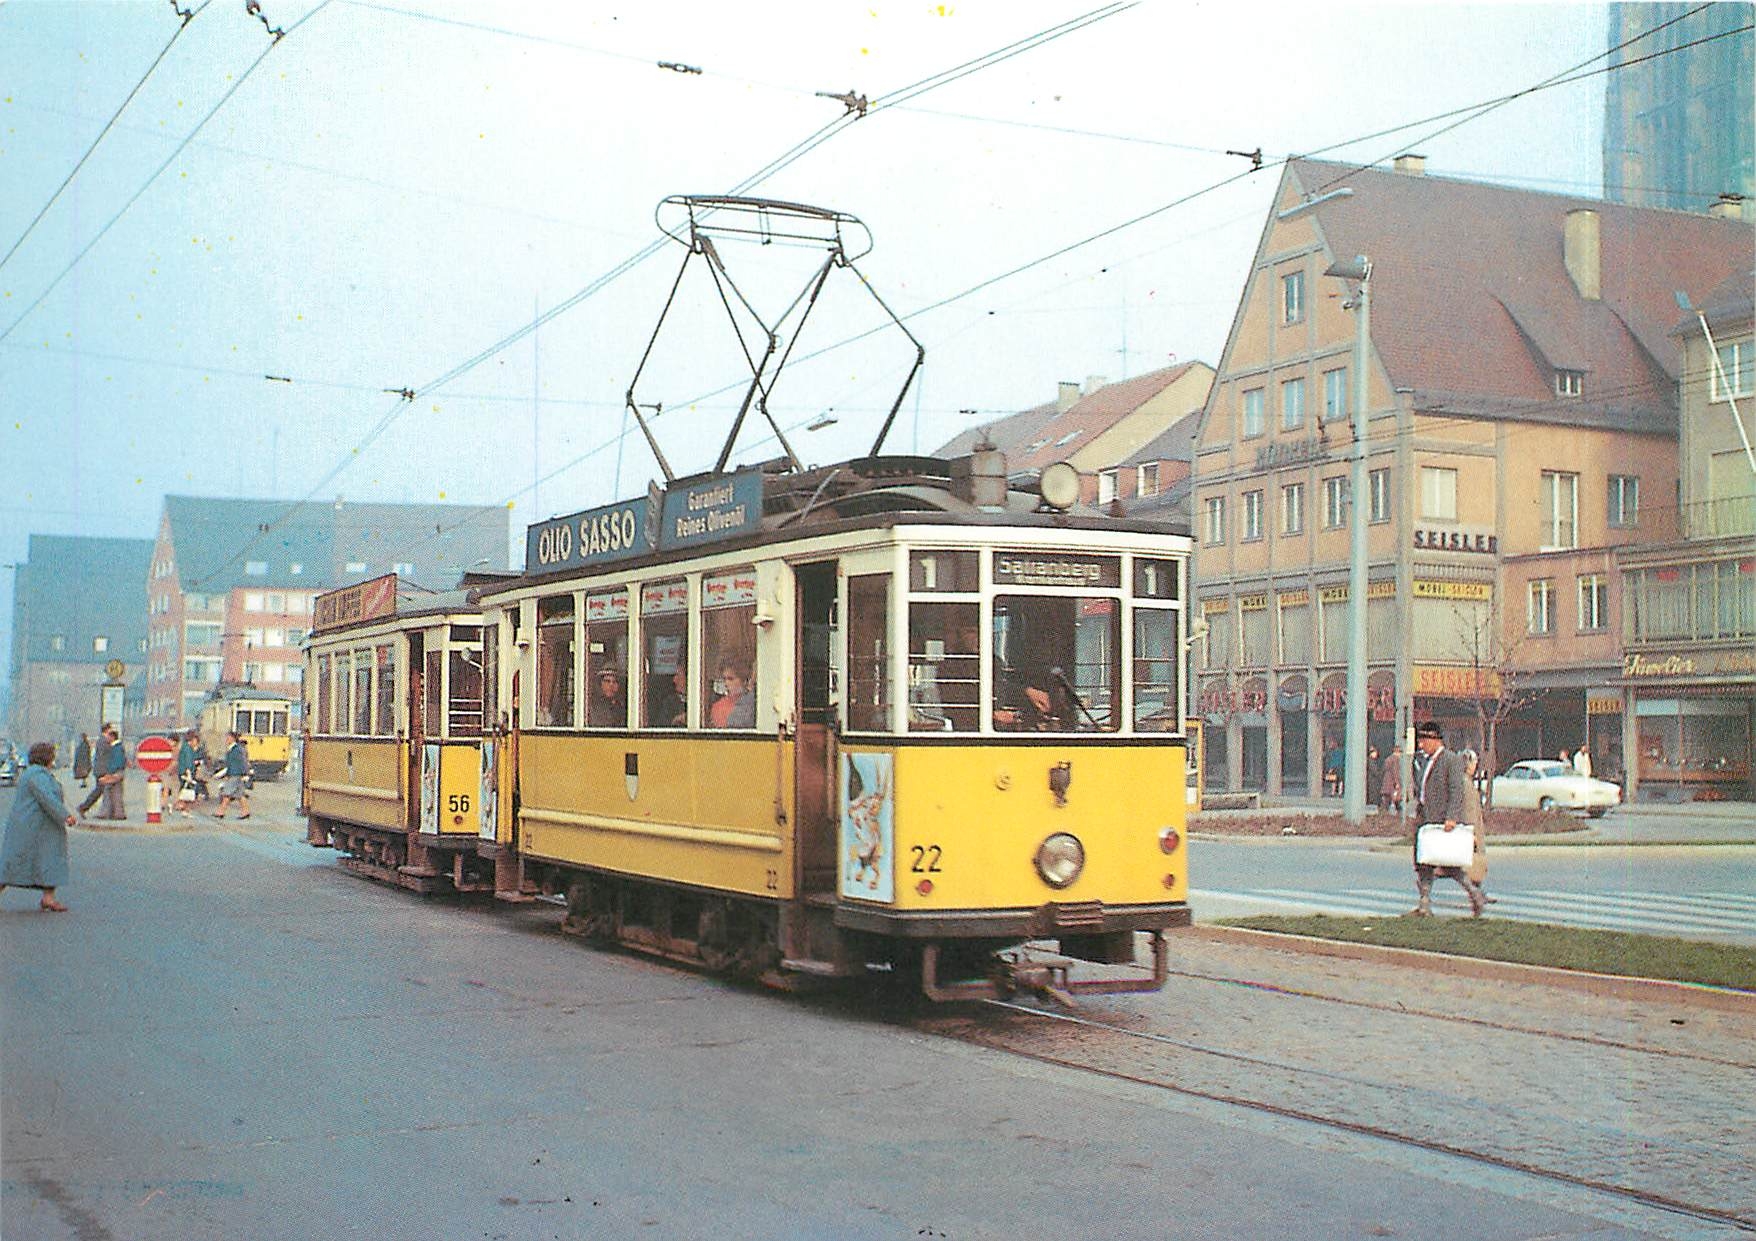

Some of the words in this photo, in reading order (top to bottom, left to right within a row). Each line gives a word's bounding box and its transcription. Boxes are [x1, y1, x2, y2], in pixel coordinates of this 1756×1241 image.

[688, 483, 734, 510] Garantiert
[538, 524, 572, 565] OLIO
[579, 509, 636, 558] SASSO
[676, 515, 707, 539] Reines
[707, 505, 746, 532] Olivenöl
[1414, 530, 1497, 553] SEISLER
[920, 557, 937, 588] 1
[1144, 564, 1157, 595] 1
[448, 795, 470, 813] 56
[911, 844, 942, 873] 22
